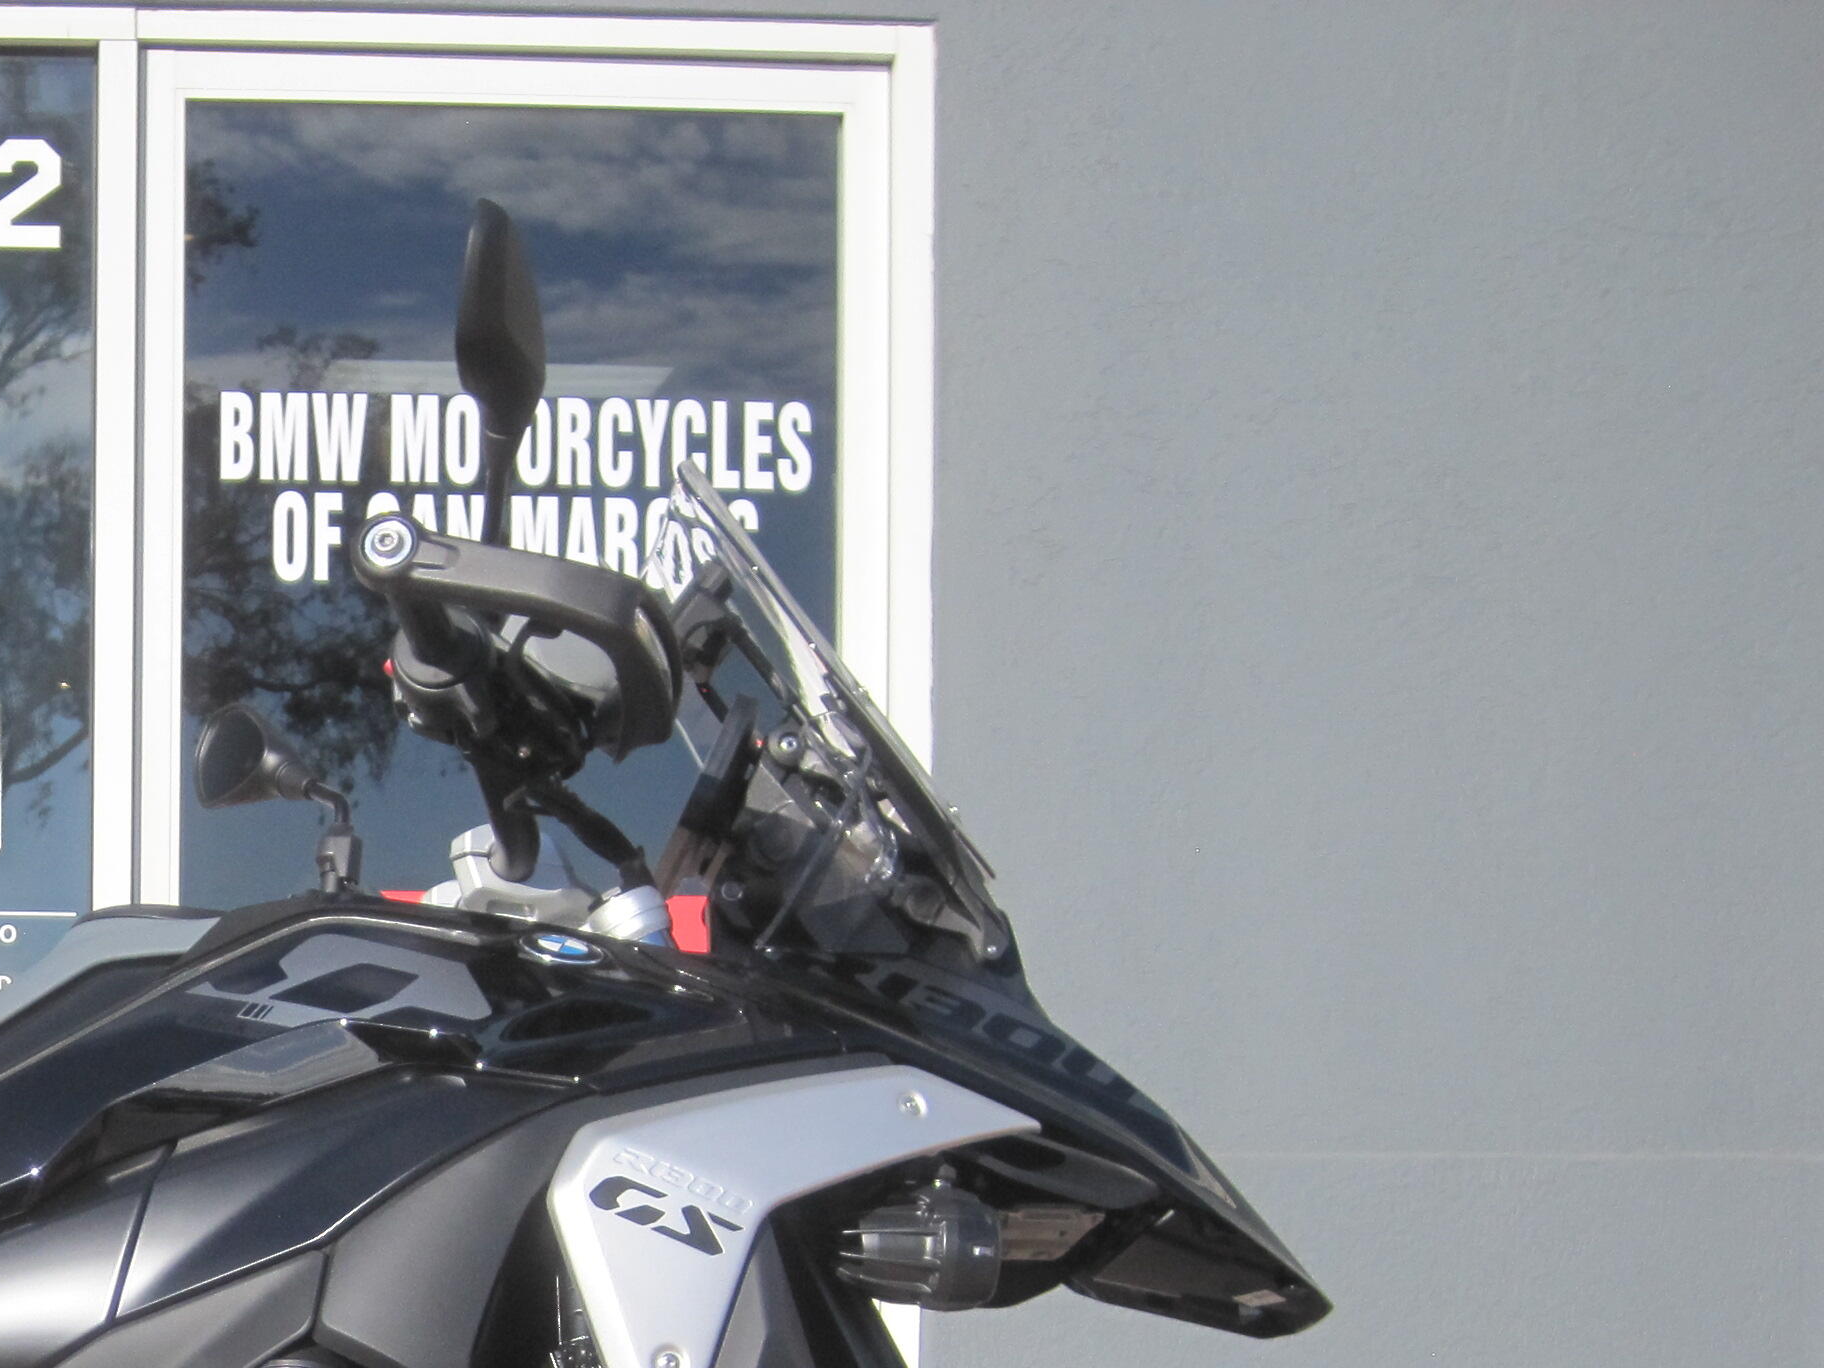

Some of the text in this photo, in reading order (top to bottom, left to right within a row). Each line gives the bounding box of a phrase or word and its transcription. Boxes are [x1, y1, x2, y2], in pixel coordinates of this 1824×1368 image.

[219, 391, 813, 492] BMW MOORCYCLES
[273, 490, 343, 582] OF
[589, 1175, 745, 1256] GS
